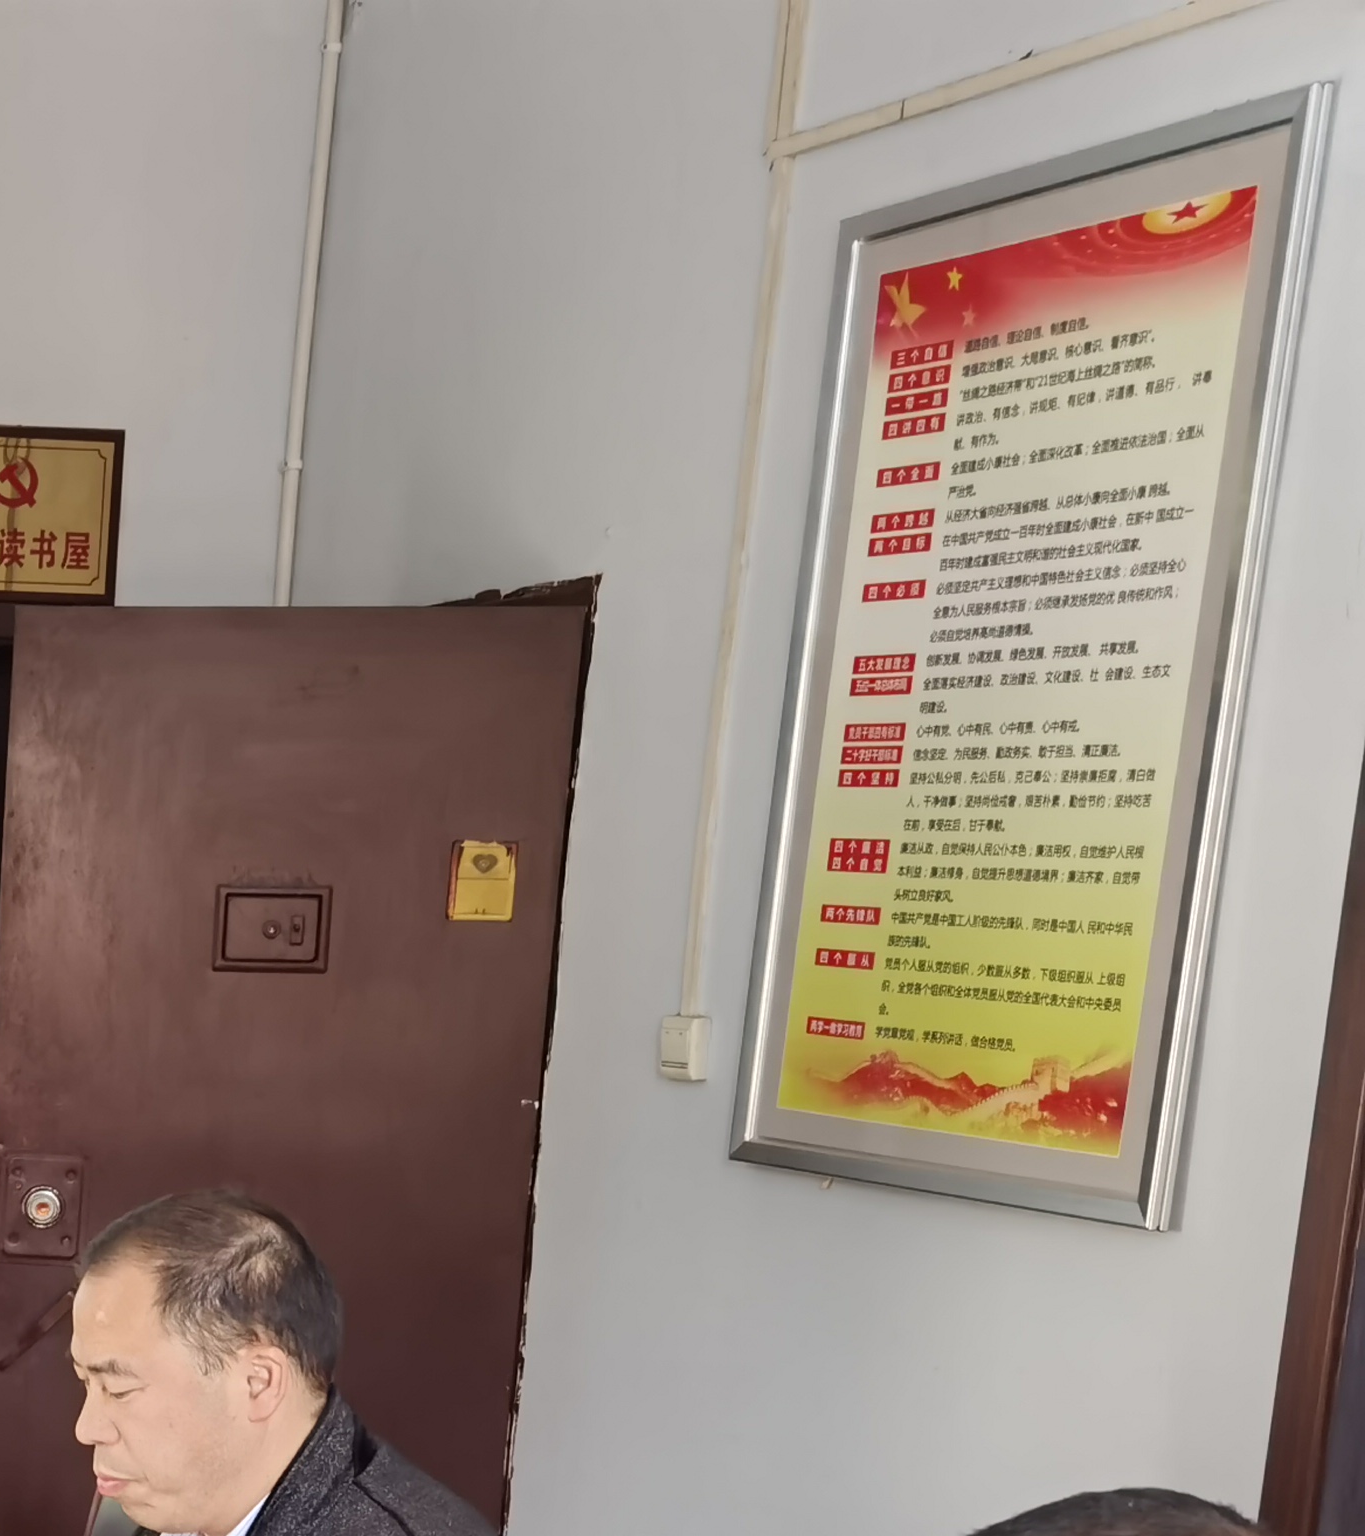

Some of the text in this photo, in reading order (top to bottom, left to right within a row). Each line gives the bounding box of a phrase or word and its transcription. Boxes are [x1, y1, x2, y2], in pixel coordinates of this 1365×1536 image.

[896, 343, 948, 366] 三个自信
[893, 369, 946, 390] 四个意识
[882, 464, 935, 485] 四个全面
[876, 511, 929, 531] 两个跨越
[874, 535, 927, 554] 两个目标
[867, 582, 920, 600] 四个必须
[858, 657, 910, 672] 五大发展理念
[842, 771, 895, 786] 四个坚持
[825, 907, 876, 923] 两个先锋队
